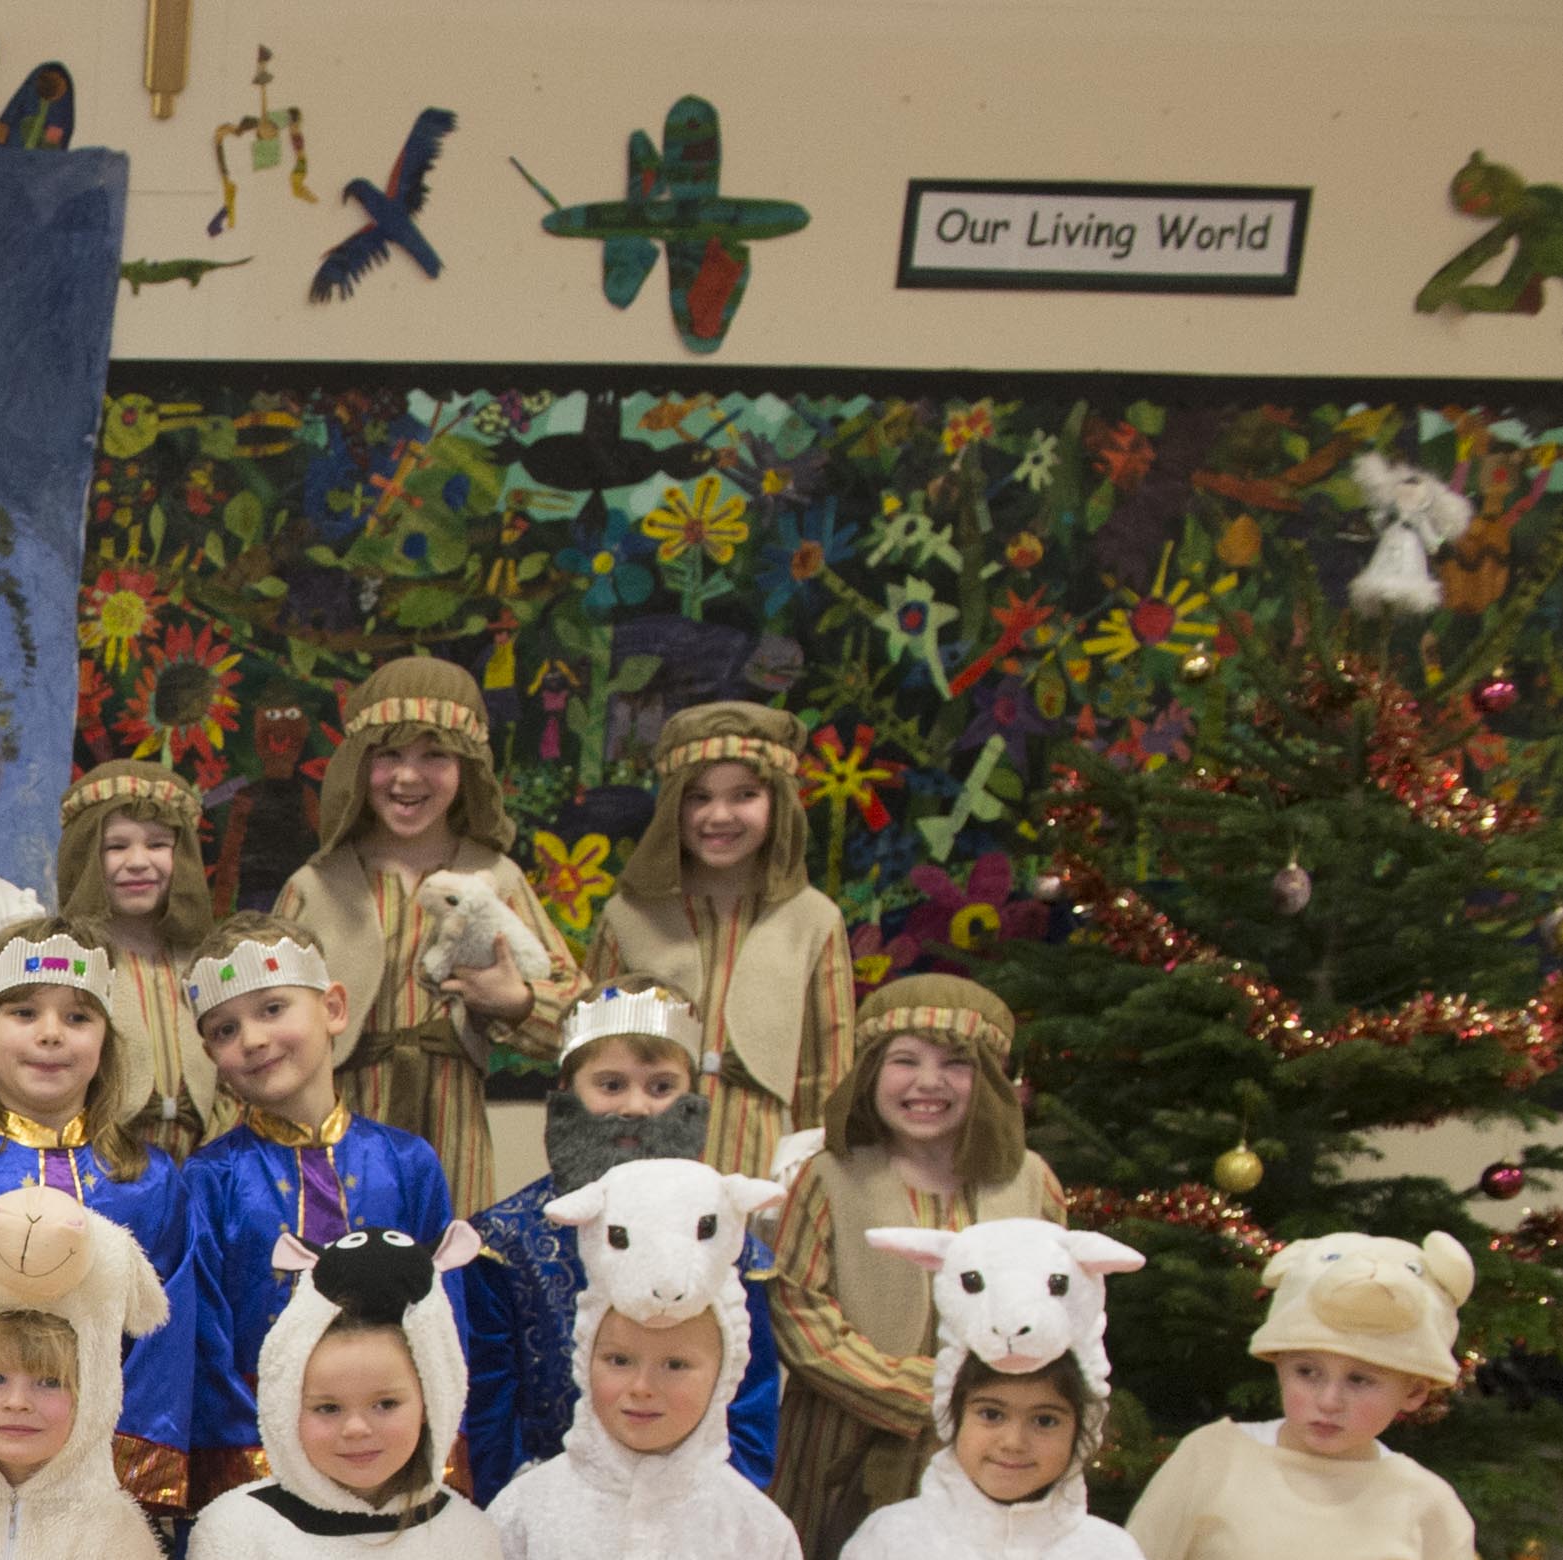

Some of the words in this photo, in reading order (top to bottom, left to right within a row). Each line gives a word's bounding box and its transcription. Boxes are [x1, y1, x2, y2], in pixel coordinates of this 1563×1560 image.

[935, 207, 1011, 245] Our
[1026, 210, 1136, 259] Living
[1157, 213, 1272, 250] World
